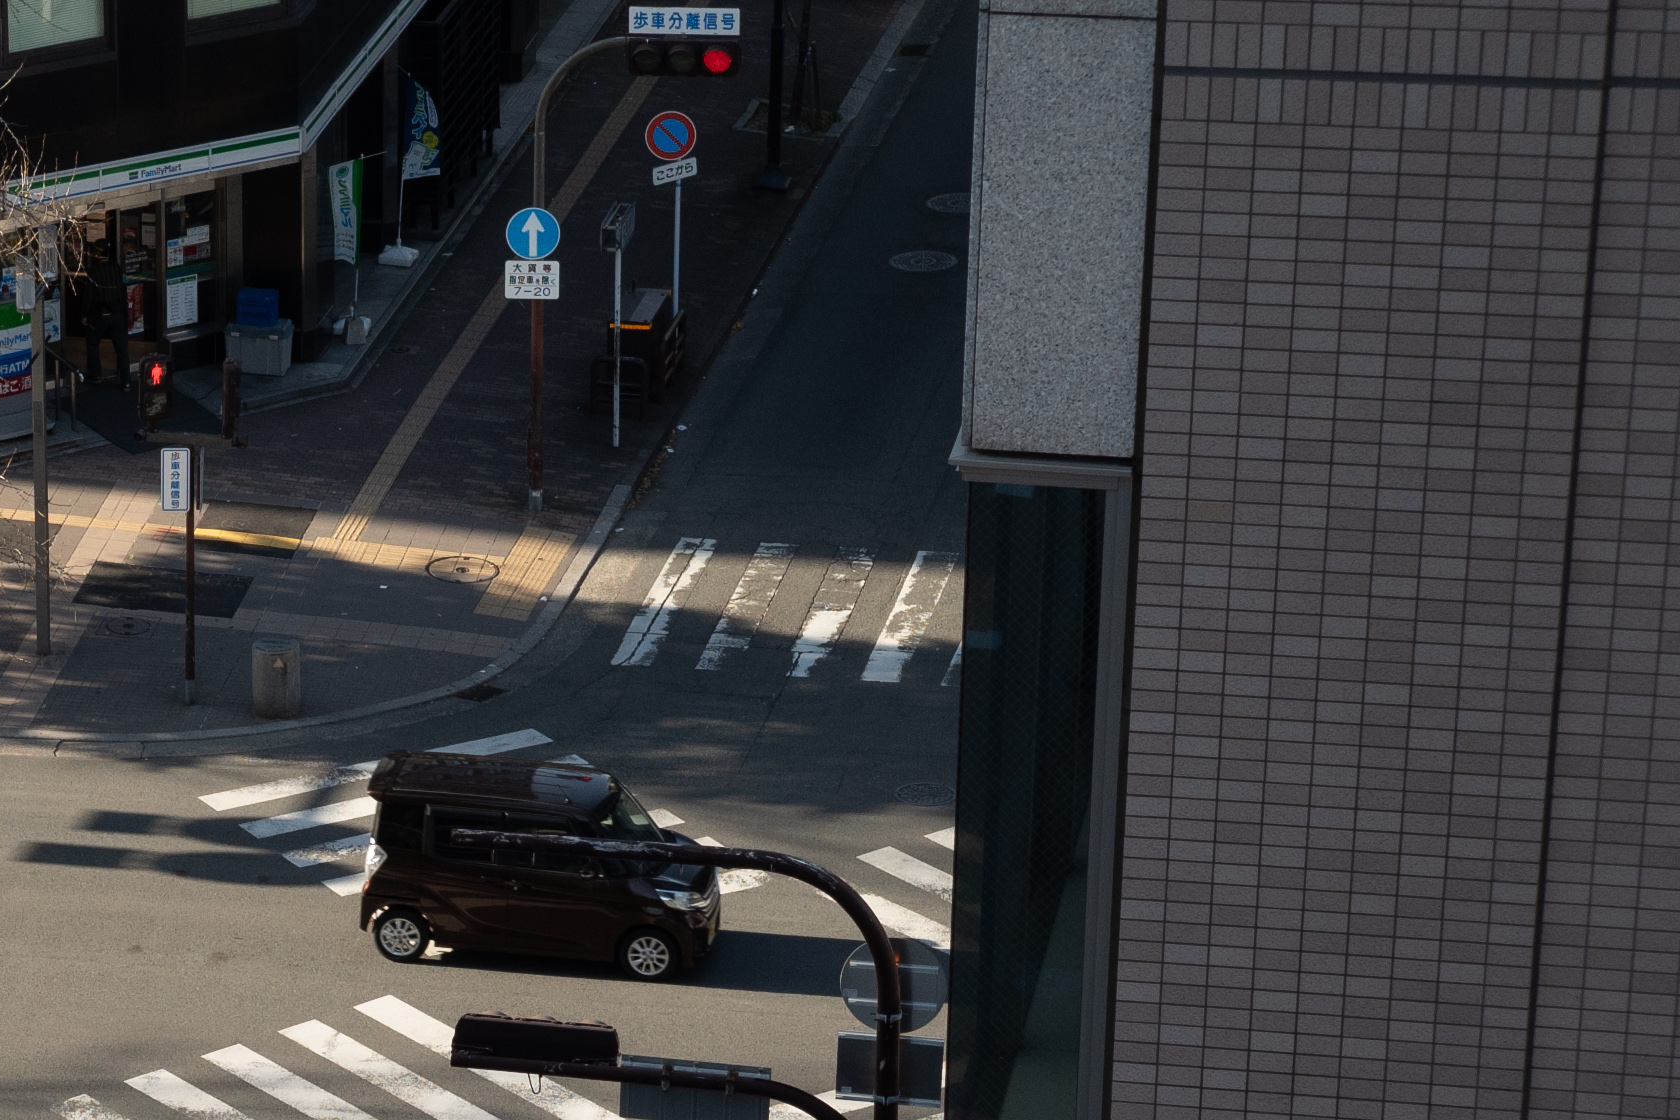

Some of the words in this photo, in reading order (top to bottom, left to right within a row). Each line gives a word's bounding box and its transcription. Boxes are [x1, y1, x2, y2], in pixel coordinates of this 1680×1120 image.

[633, 11, 735, 30] 歩車分離信号
[141, 163, 182, 178] FamilyMart
[656, 162, 694, 181] ここから
[514, 286, 551, 297] 7-20
[170, 451, 180, 509] 歩車分離信号
